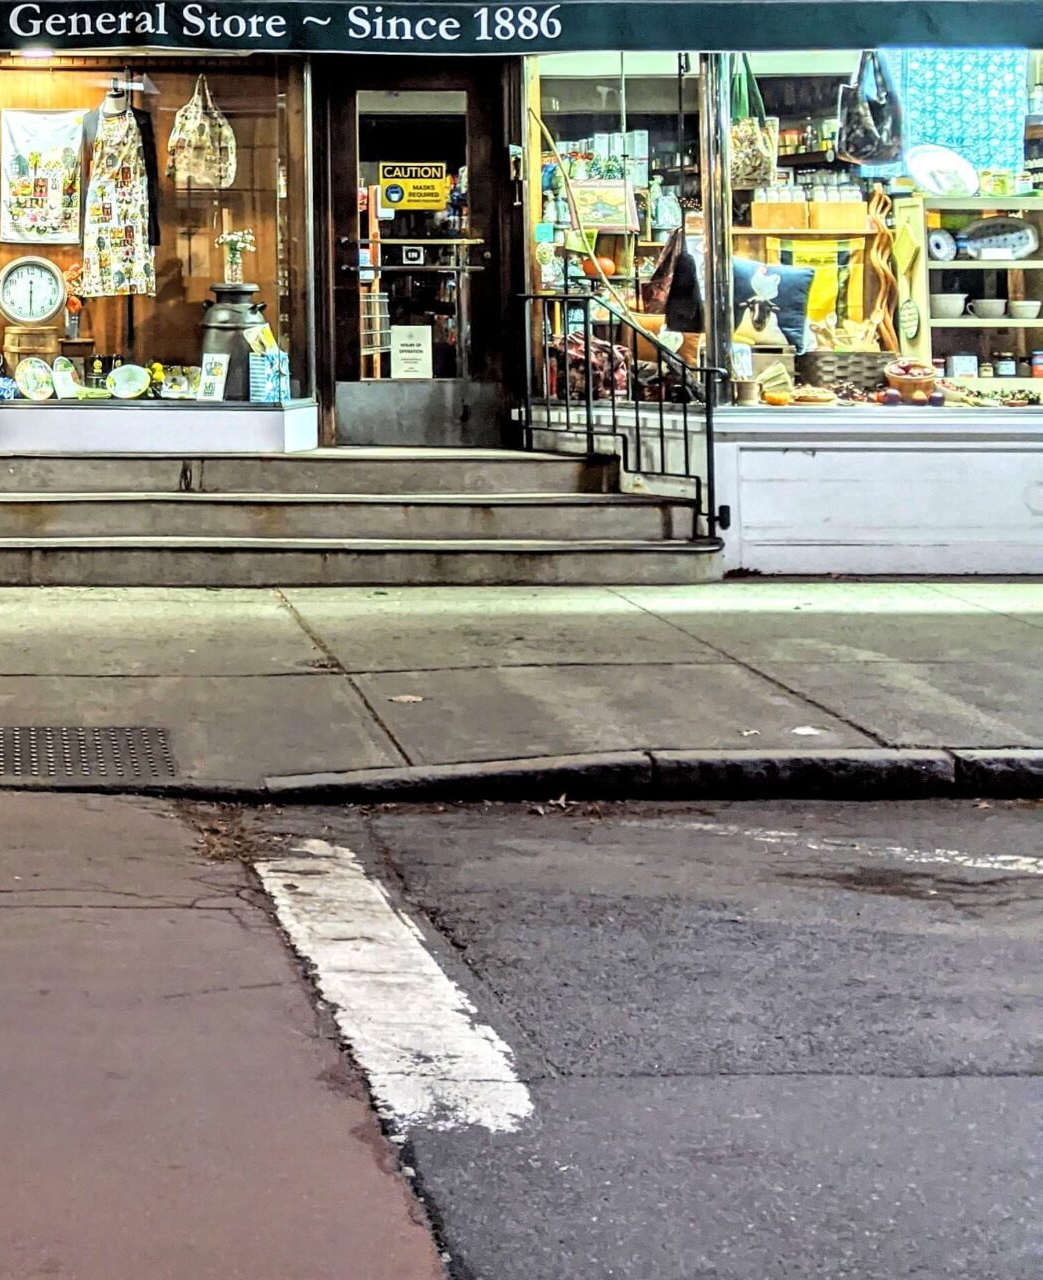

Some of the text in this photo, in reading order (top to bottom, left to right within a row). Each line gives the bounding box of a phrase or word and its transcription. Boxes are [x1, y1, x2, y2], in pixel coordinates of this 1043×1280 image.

[10, 3, 169, 37] General
[183, 4, 287, 38] Store
[349, 5, 461, 40] Since
[474, 5, 562, 41] 1886
[383, 166, 442, 178] CAUTION
